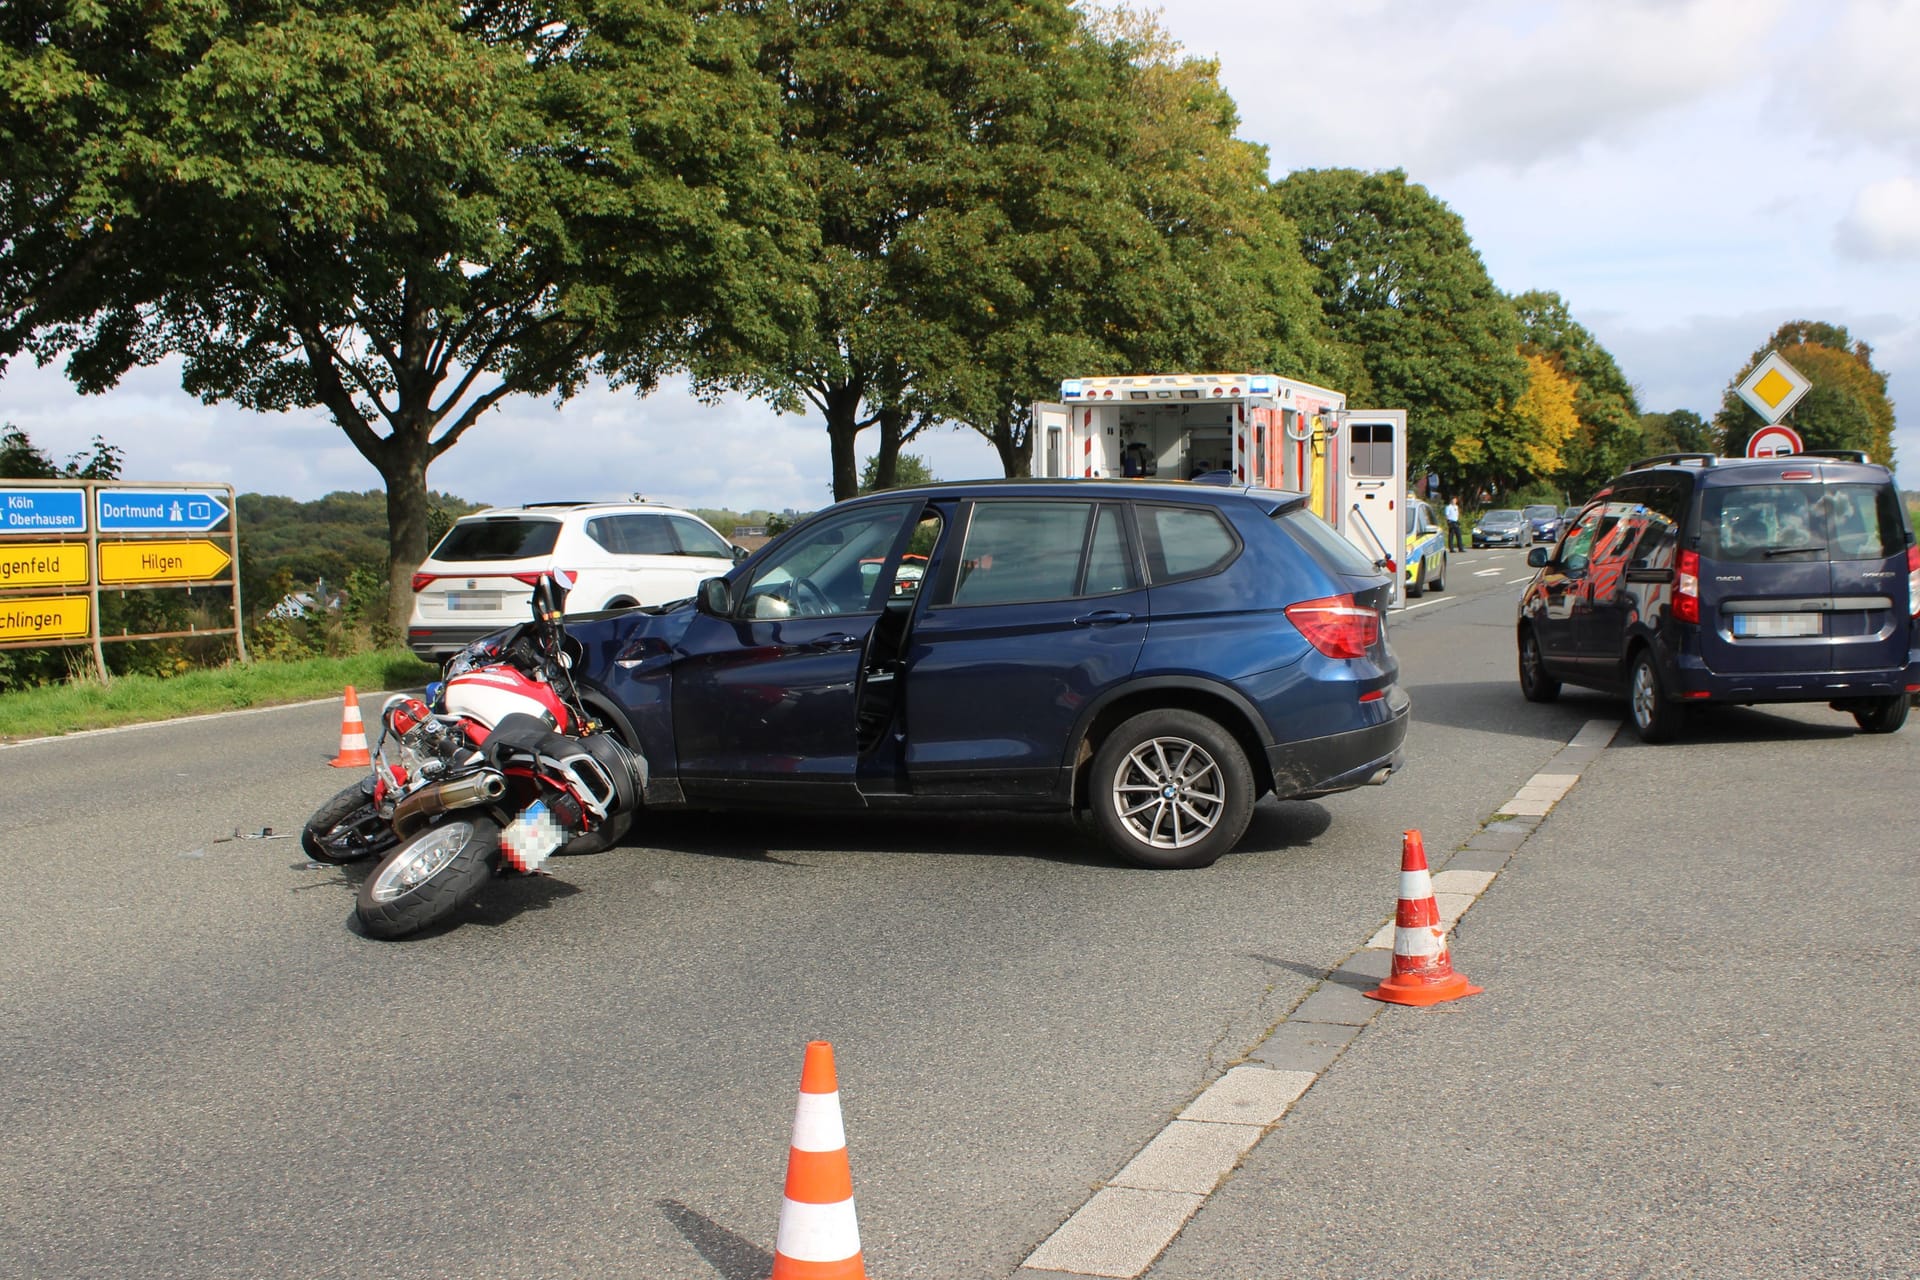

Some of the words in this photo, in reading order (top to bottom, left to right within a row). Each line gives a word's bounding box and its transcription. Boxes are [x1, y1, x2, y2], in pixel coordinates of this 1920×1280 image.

[8, 496, 34, 509] Köln
[103, 503, 164, 518] Dortmund
[196, 505, 202, 517] 1
[9, 513, 75, 526] Oberhausen
[0, 556, 60, 579] genfeld
[141, 554, 183, 573] Hilgen
